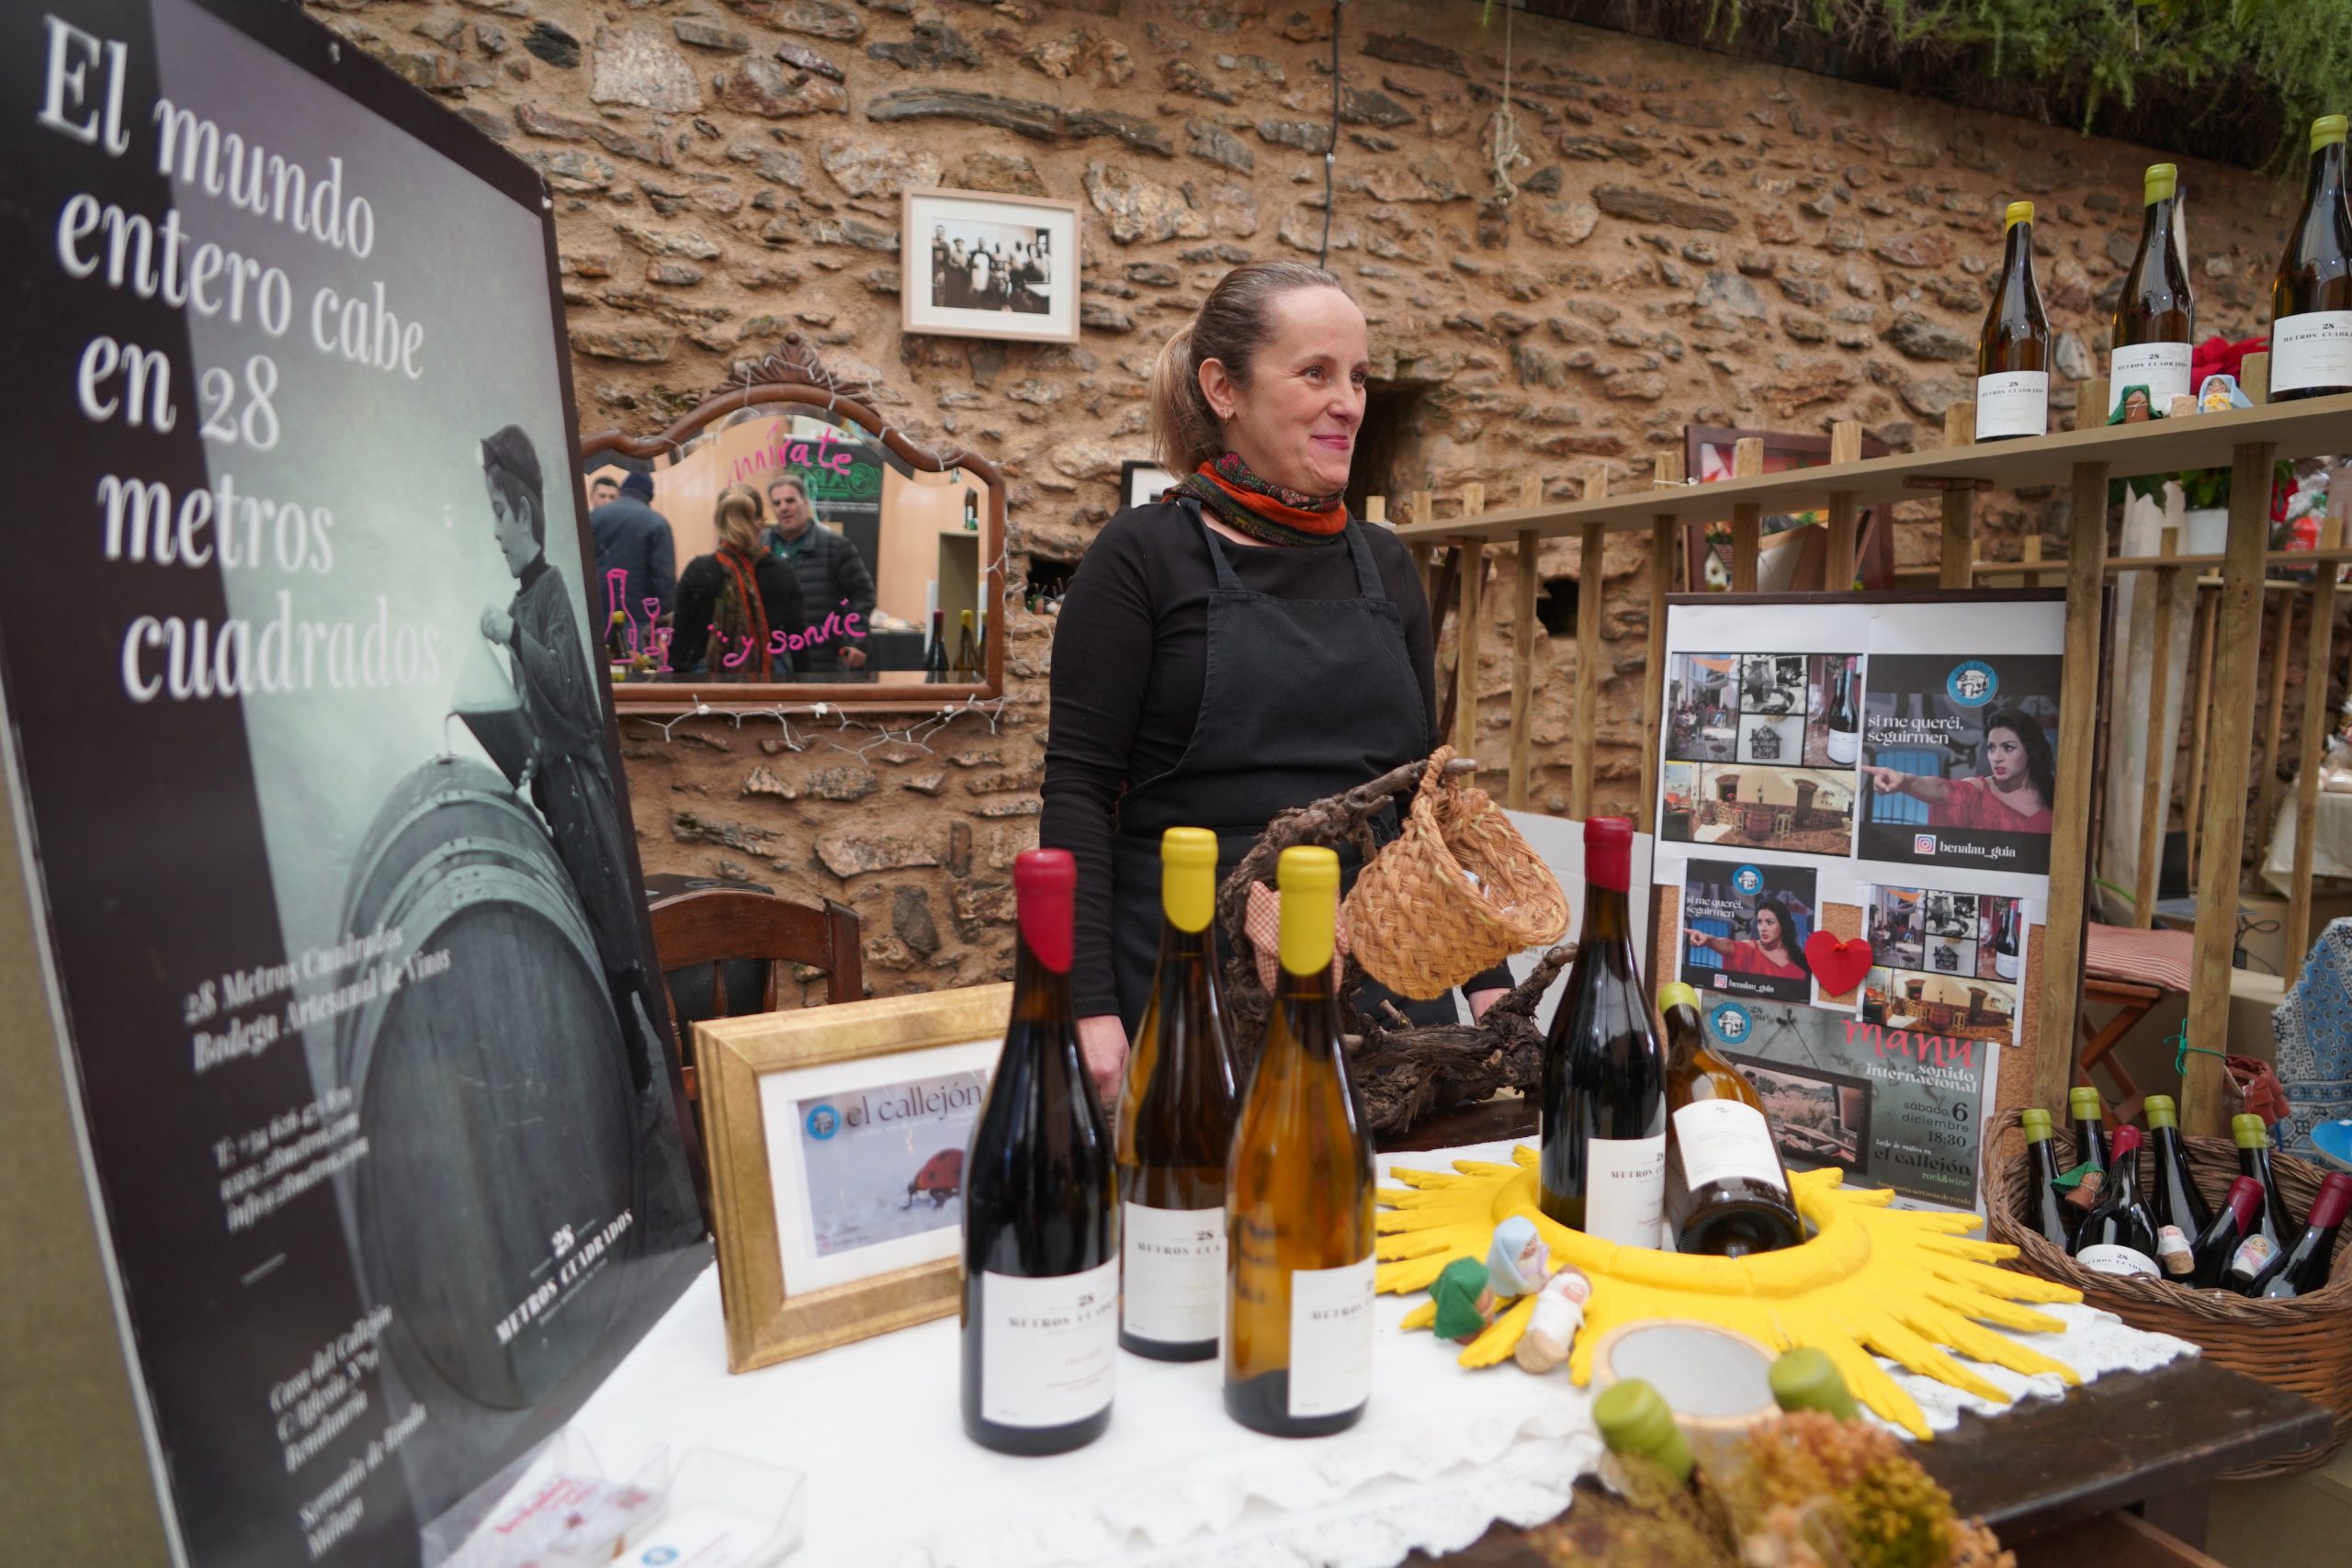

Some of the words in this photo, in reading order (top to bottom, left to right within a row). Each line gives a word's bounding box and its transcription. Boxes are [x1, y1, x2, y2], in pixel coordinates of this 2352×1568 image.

[38, 14, 129, 156] El
[153, 96, 376, 259] mundo
[56, 192, 293, 338] entero
[311, 280, 426, 380] cabe
[2283, 333, 2317, 343] METROS
[2117, 361, 2145, 371] METROS
[2147, 361, 2188, 369] CUADRADOS
[77, 334, 175, 434] en
[199, 355, 280, 452] 28
[98, 472, 334, 574] metros
[121, 590, 443, 703] cuadrados
[1868, 715, 1880, 727] si
[1883, 717, 1907, 728] me
[1911, 716, 1964, 730] queréi,
[1867, 730, 1949, 746] seguirmen
[1939, 840, 2016, 860] benalau_guia
[1686, 906, 1735, 919] seguirmen
[185, 979, 216, 1025] 28
[221, 961, 299, 1012] Metros
[303, 922, 403, 979] Cuadrados
[193, 1014, 279, 1075] Bodega
[1840, 1019, 1976, 1068] manu
[1866, 1063, 1976, 1093] internacional
[1917, 1065, 1975, 1083] sonido
[846, 1095, 870, 1127] el
[878, 1081, 982, 1121] callejón
[1952, 1102, 1968, 1122] 6
[1902, 1113, 1970, 1133] diciembre
[1928, 1131, 1966, 1147] 18:30
[1874, 1147, 1890, 1161] el
[1894, 1153, 1971, 1177] callejón
[1611, 1168, 1653, 1179] METROS
[1922, 1172, 1970, 1187] rock&wine
[551, 1224, 574, 1258] 28
[1197, 1231, 1214, 1242] 28
[1137, 1241, 1190, 1256] METROS
[496, 1278, 558, 1345] METROS
[560, 1207, 633, 1285] CUADRADOS
[1077, 1292, 1094, 1307] 28
[1008, 1316, 1070, 1328] METROS
